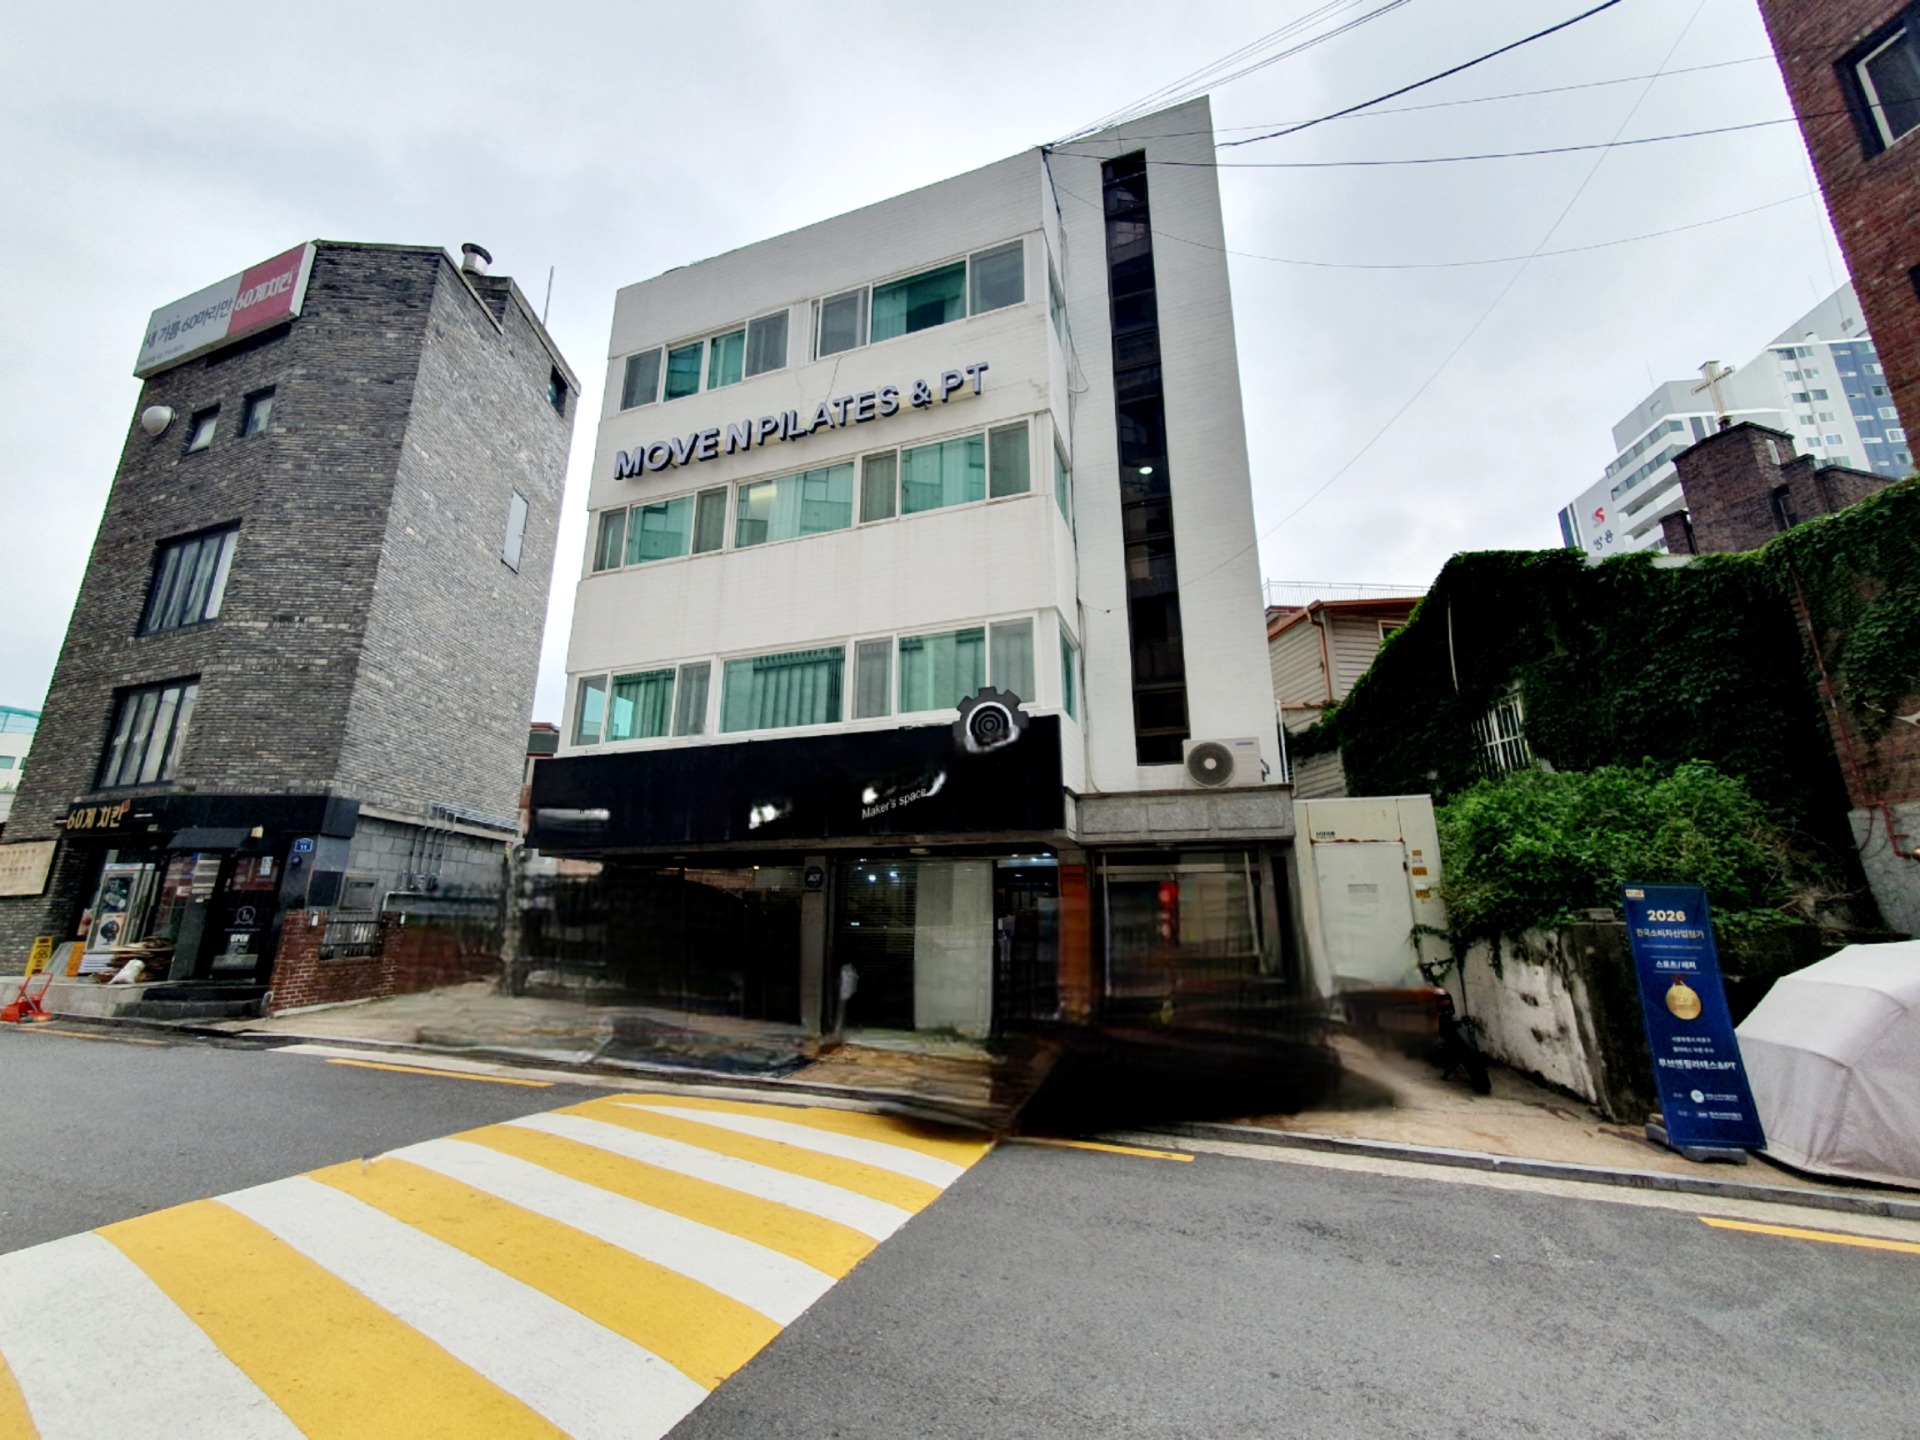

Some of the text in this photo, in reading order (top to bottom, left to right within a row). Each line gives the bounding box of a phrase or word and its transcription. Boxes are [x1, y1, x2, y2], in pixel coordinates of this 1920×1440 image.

[158, 319, 182, 343] 기름
[181, 297, 233, 332] 60마리만
[613, 361, 989, 480] MOVE N PILATES & PT
[861, 788, 927, 820] Maker's space
[807, 873, 821, 881] ADT
[1646, 910, 1686, 922] 2026
[230, 934, 250, 943] OPEN
